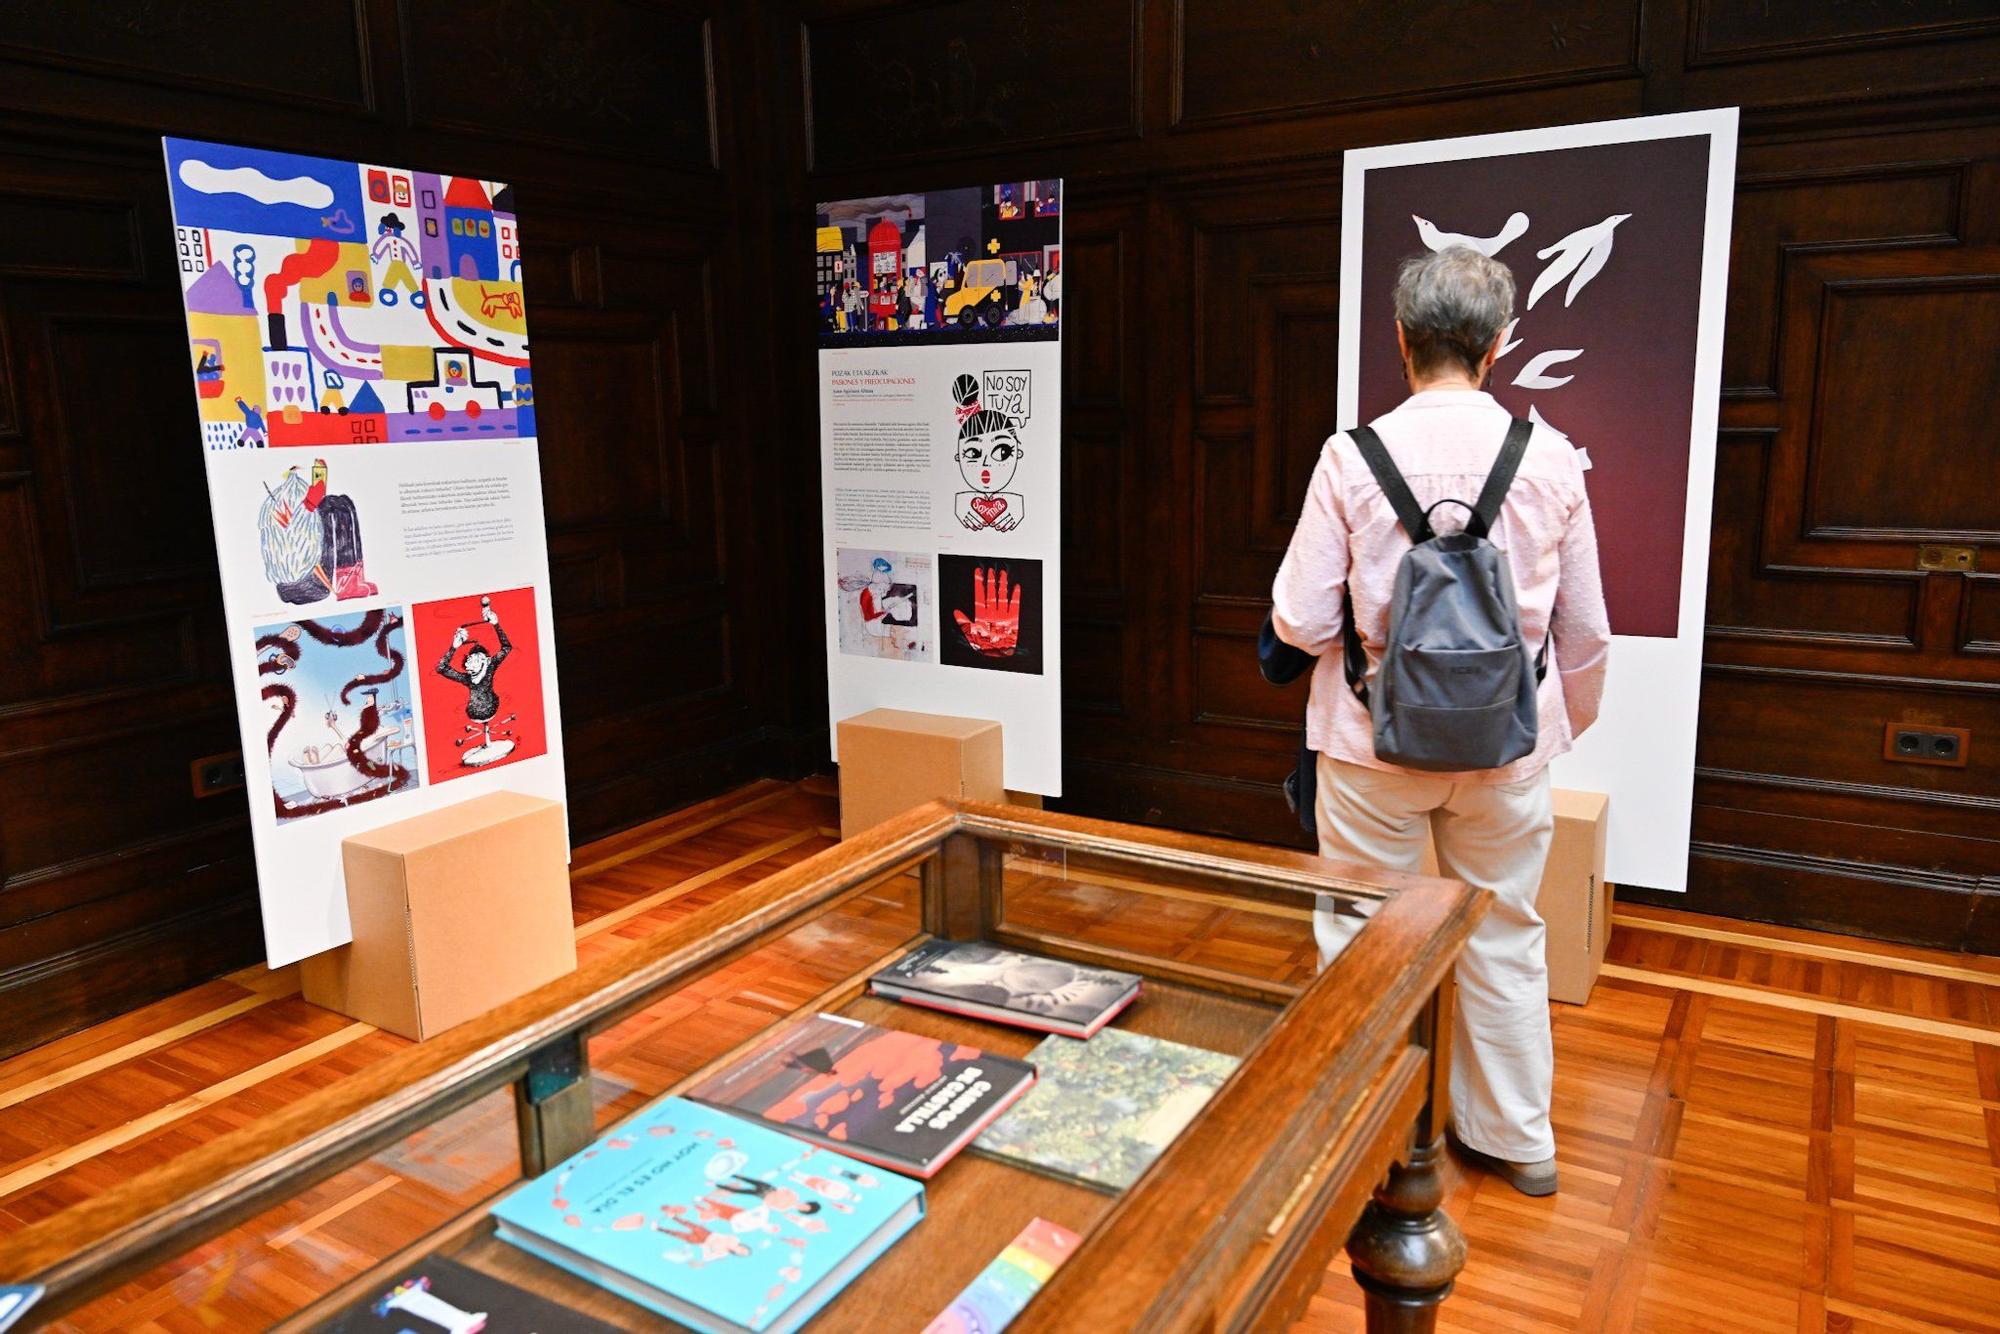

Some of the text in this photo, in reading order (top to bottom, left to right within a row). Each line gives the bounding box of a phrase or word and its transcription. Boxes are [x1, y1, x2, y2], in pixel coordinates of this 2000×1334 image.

[864, 377, 916, 385] PREOCUPACIONES
[986, 375, 1028, 392] NO SOY
[954, 1066, 984, 1085] DE
[894, 1081, 966, 1133] CASTILLA
[927, 1080, 992, 1130] CAMPOS
